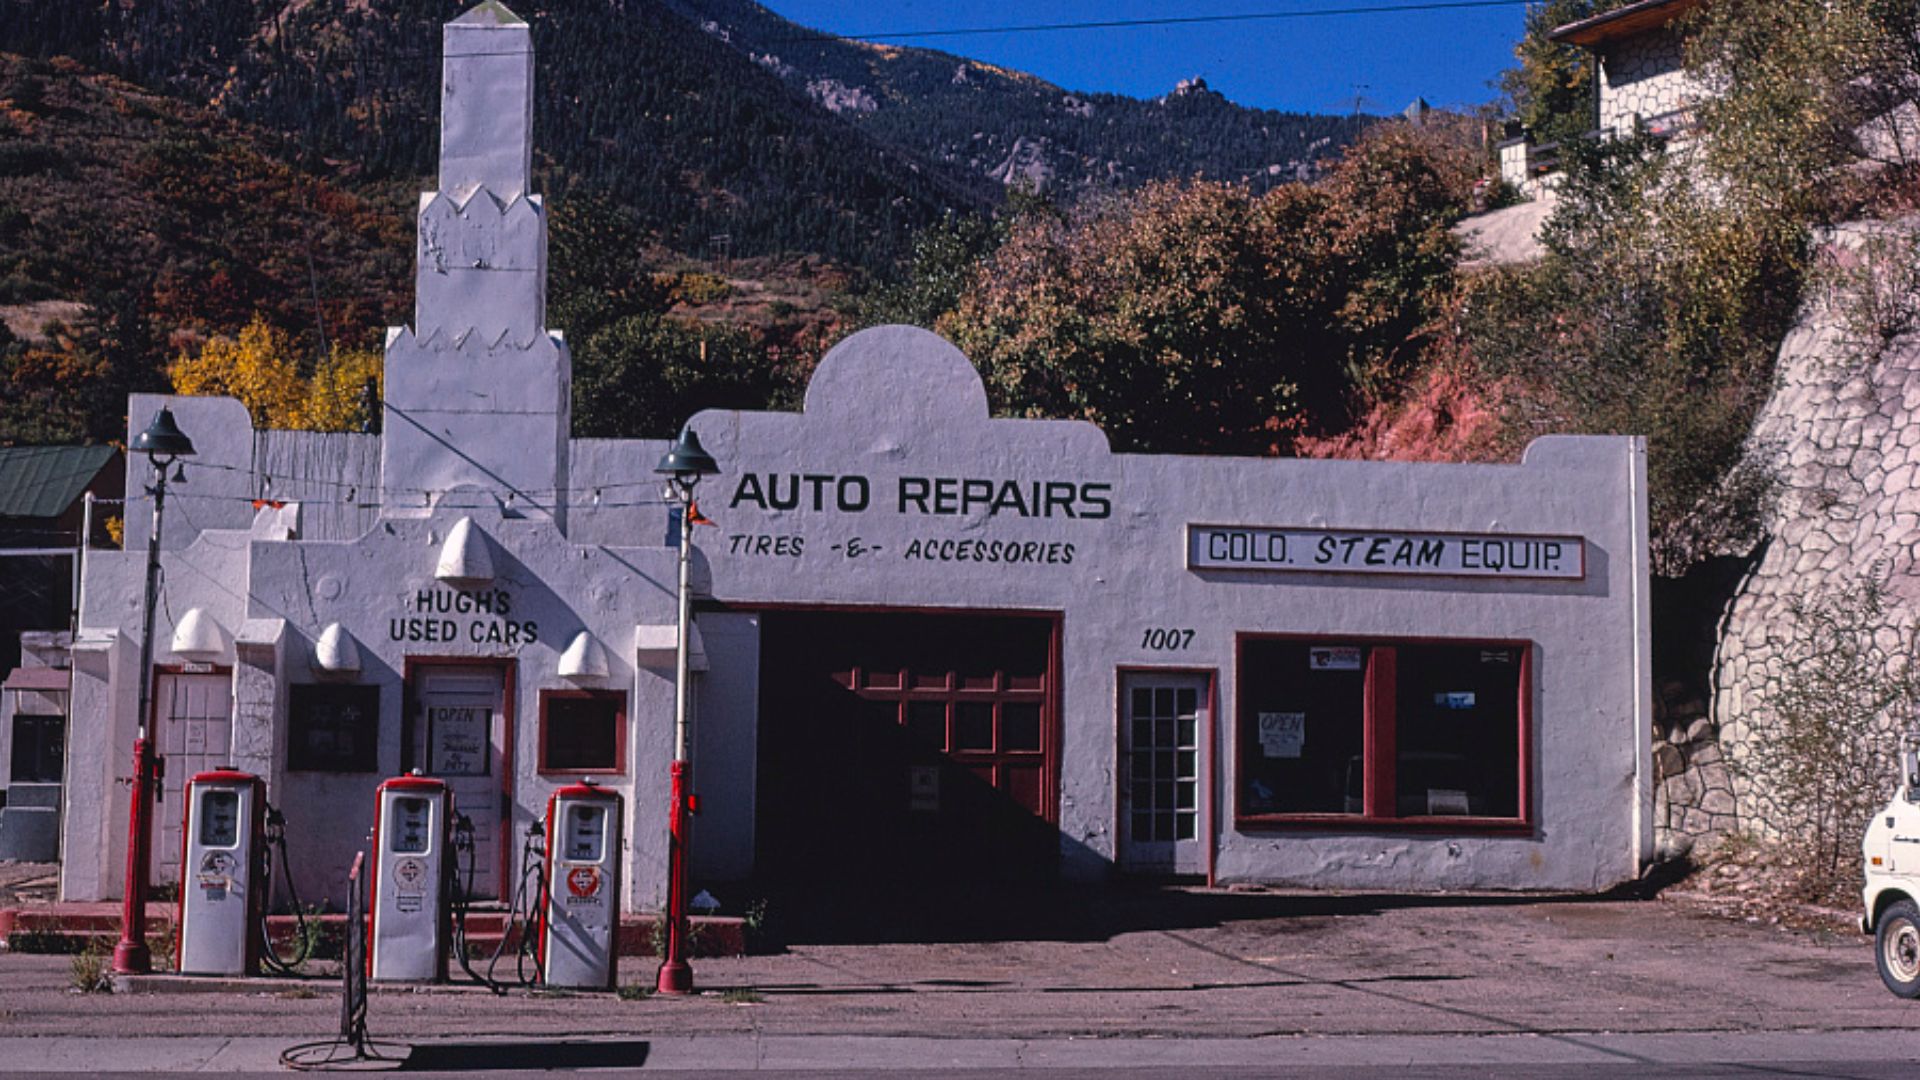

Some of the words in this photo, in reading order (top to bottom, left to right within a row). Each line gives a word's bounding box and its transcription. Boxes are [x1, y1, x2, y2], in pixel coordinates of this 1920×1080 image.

[728, 473, 870, 512] AUTO
[898, 477, 1112, 519] REPAIRS
[728, 535, 805, 556] TIRES
[904, 539, 1076, 564] ACCESSORIES
[1209, 532, 1294, 564] COLO.
[1314, 535, 1446, 567] STEAM
[1461, 539, 1562, 572] EQUIP.
[416, 588, 511, 615] HUGH'S
[390, 618, 458, 642] USED
[470, 620, 538, 645] CARS
[1141, 628, 1196, 650] 1007
[438, 708, 474, 722] OPEN
[1261, 714, 1302, 731] OPEN
